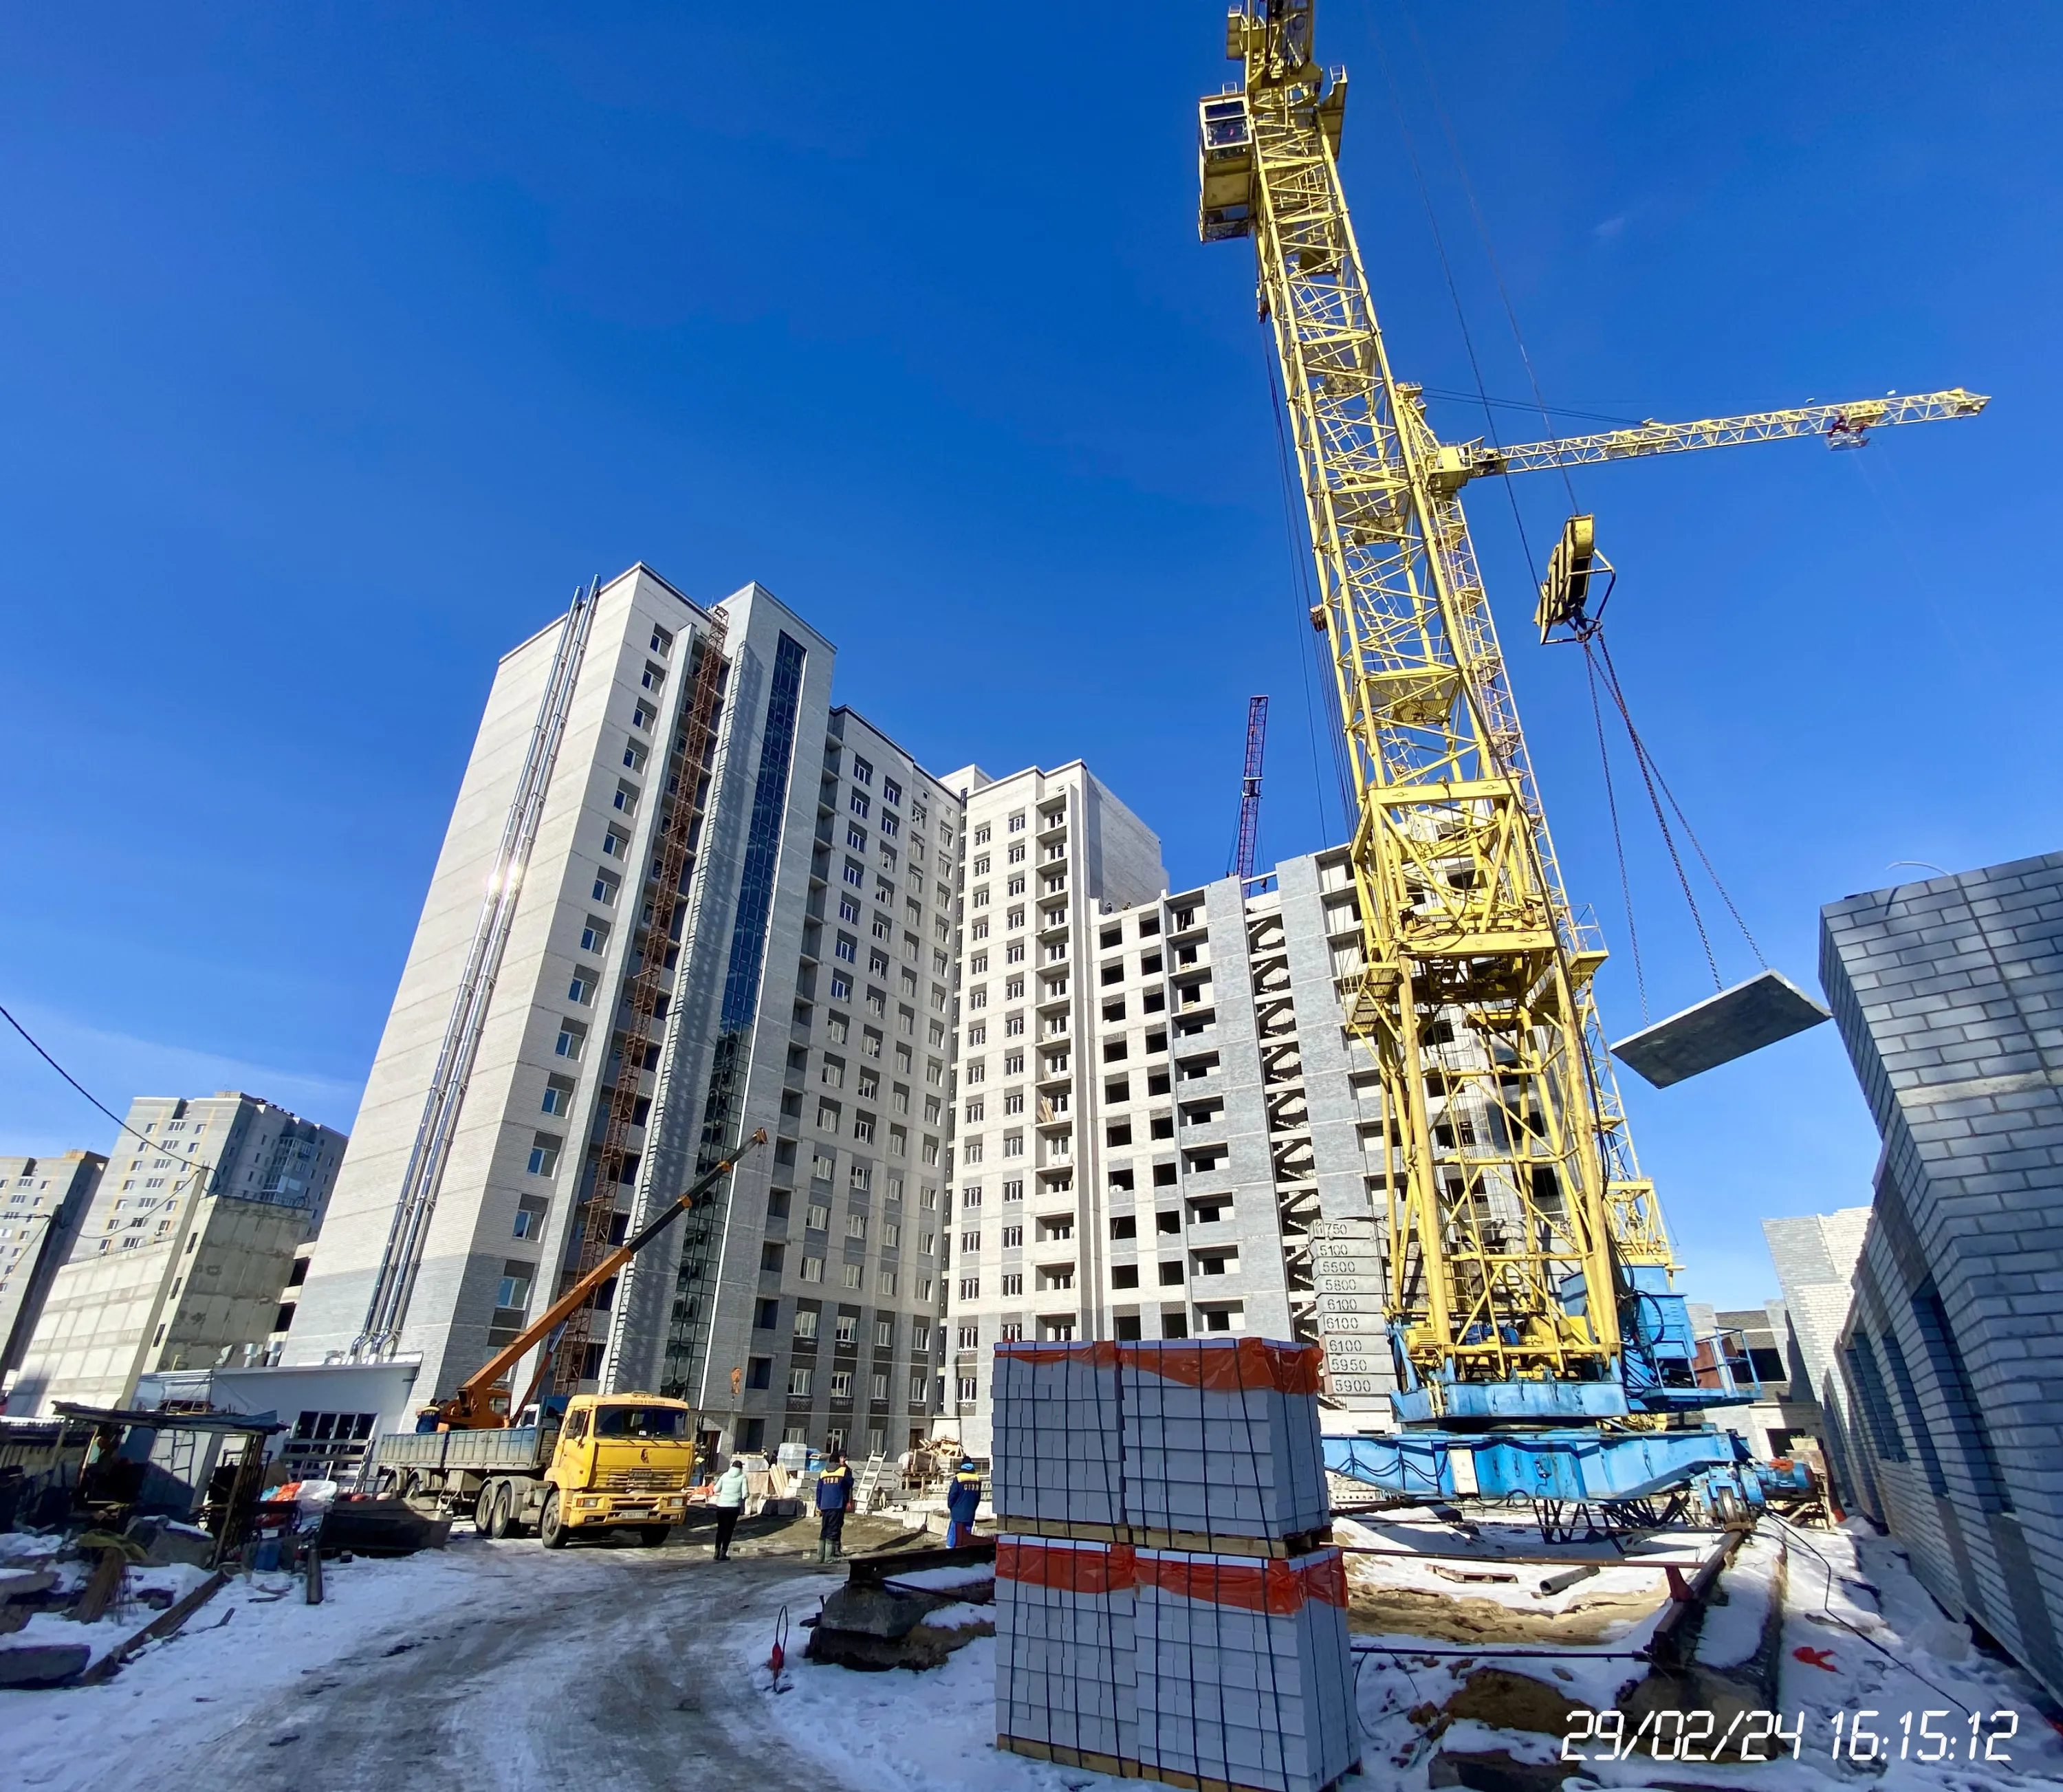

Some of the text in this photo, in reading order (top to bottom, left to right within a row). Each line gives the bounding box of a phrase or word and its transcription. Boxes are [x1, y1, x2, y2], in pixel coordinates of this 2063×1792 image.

[1320, 1244, 1348, 1256] 5100
[1322, 1261, 1355, 1273] 5500
[1325, 1279, 1357, 1291] 5800
[1327, 1298, 1357, 1311] 6100
[1327, 1317, 1359, 1329] 6100
[1329, 1340, 1362, 1352] 6100
[1331, 1359, 1367, 1371] 5950
[1335, 1379, 1371, 1392] 5900
